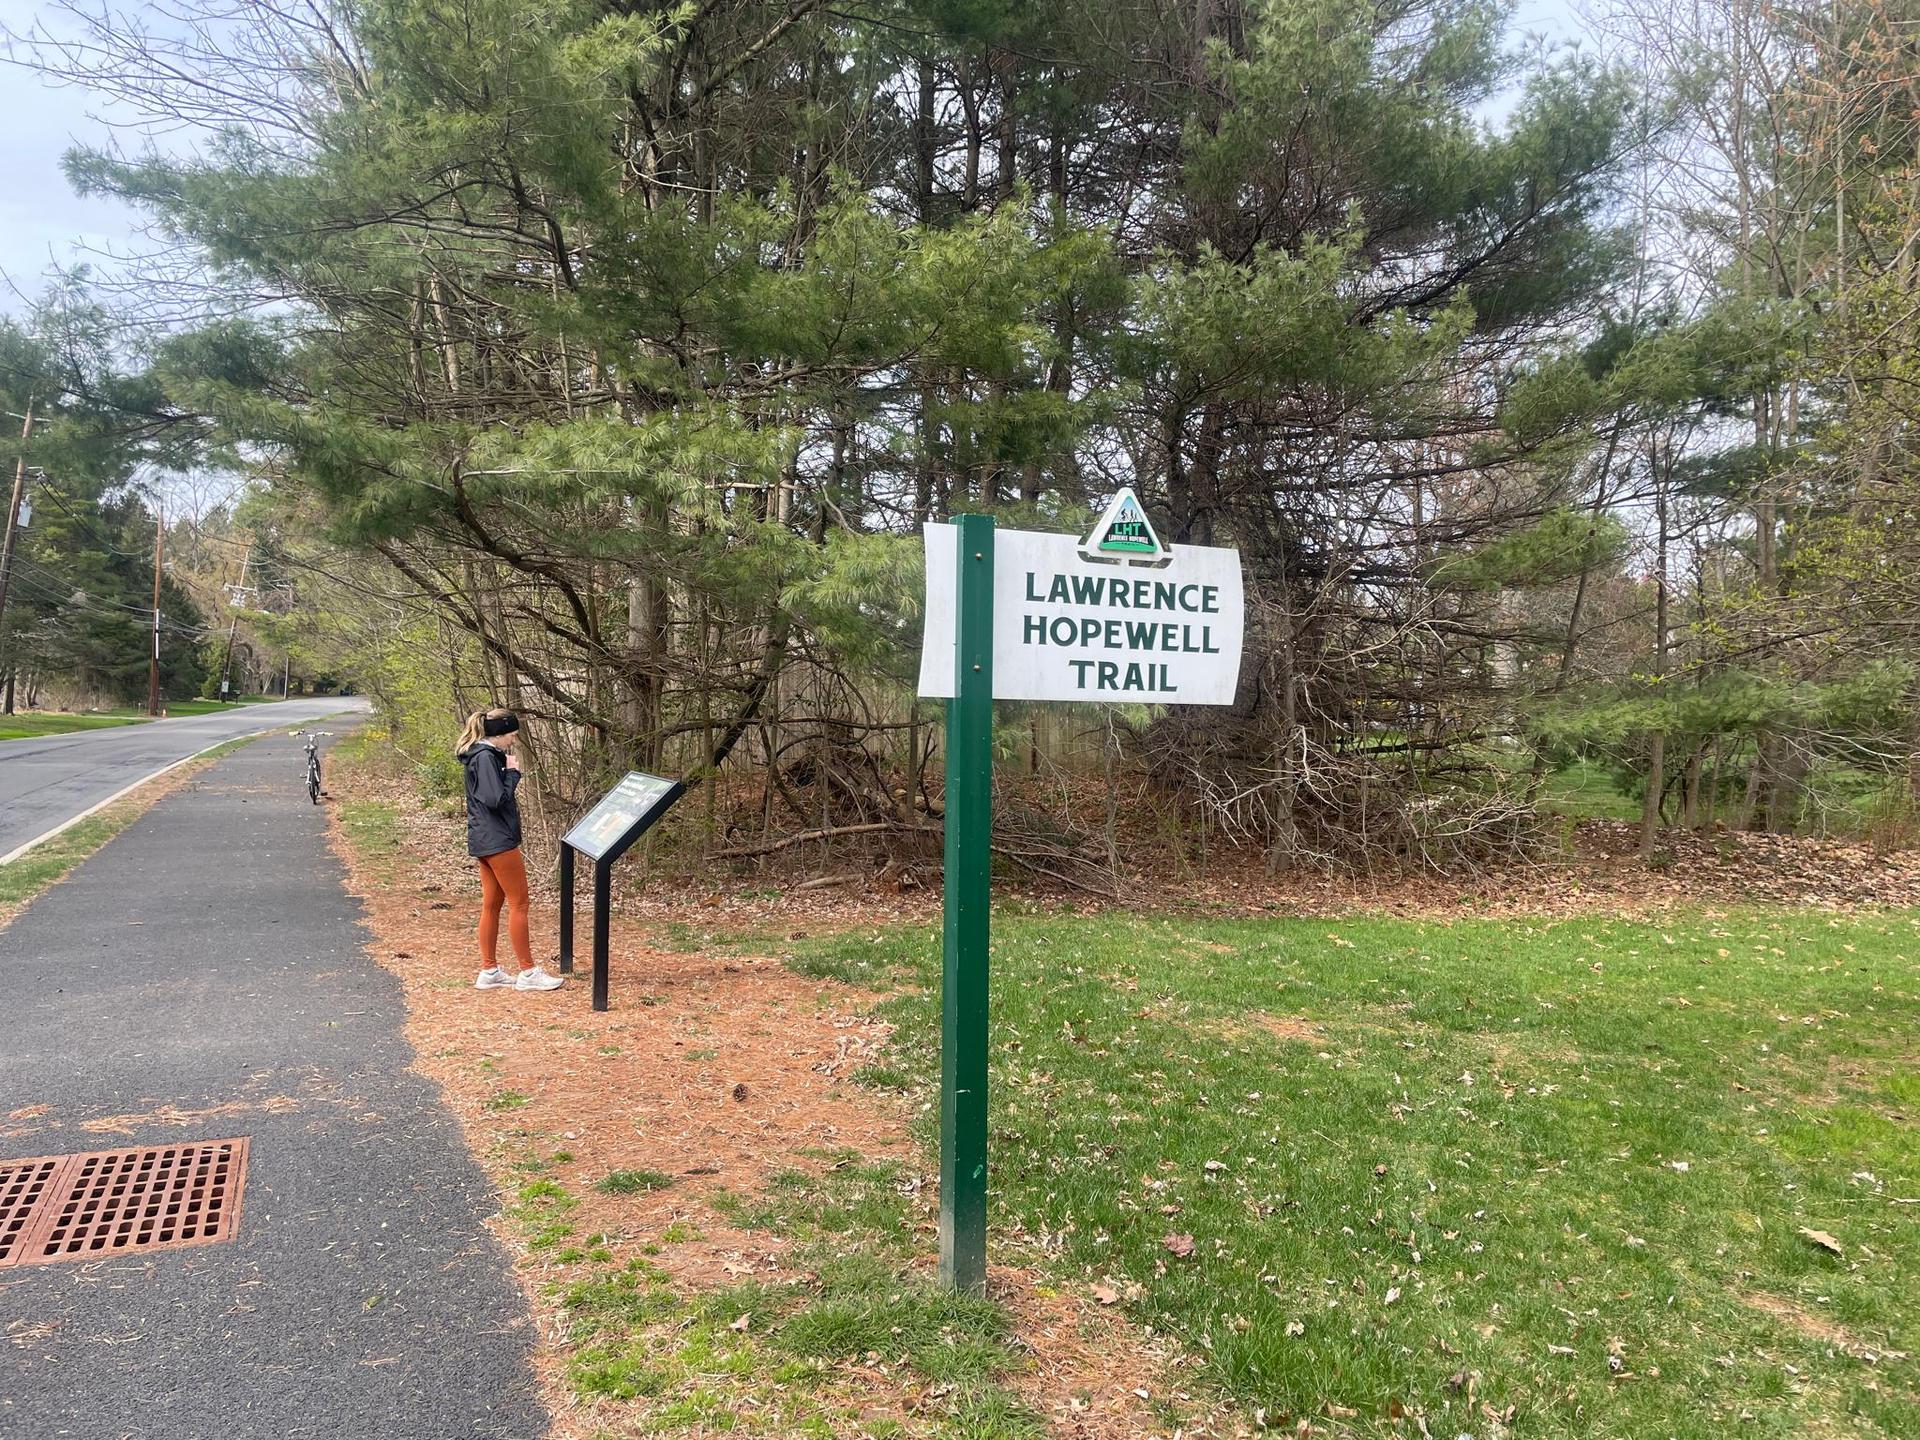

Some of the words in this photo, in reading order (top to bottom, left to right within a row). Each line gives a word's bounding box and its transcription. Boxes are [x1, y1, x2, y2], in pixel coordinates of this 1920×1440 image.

[1114, 523, 1142, 535] LHT
[1026, 572, 1219, 613] LAWRENCE
[1023, 615, 1219, 653] HOPEWELL
[1069, 660, 1178, 692] TRAIL
